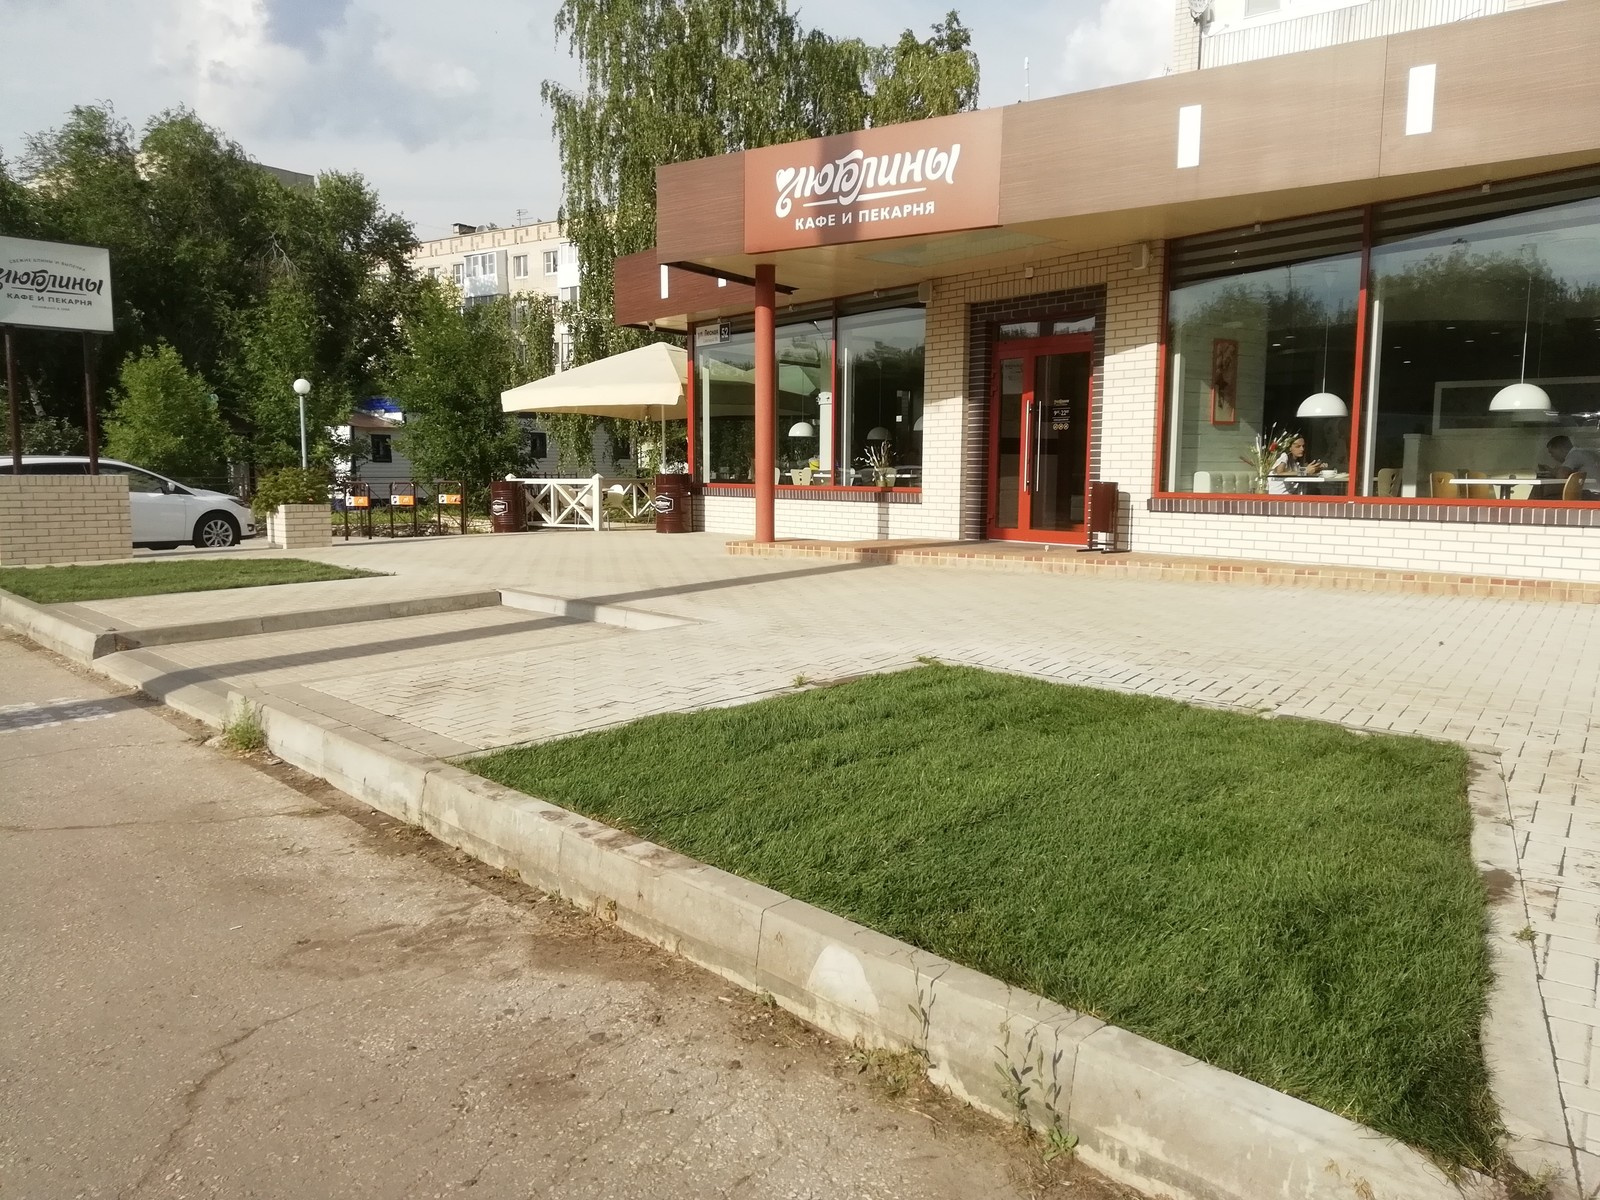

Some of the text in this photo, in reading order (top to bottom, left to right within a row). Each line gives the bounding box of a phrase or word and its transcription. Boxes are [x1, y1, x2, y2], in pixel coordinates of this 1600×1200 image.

[795, 200, 936, 231] КАФЕ И ПЕКАРНЯ
[6, 292, 35, 301] КАФЕ
[48, 296, 92, 306] ПЕКАРНЯ
[722, 328, 728, 338] 52
